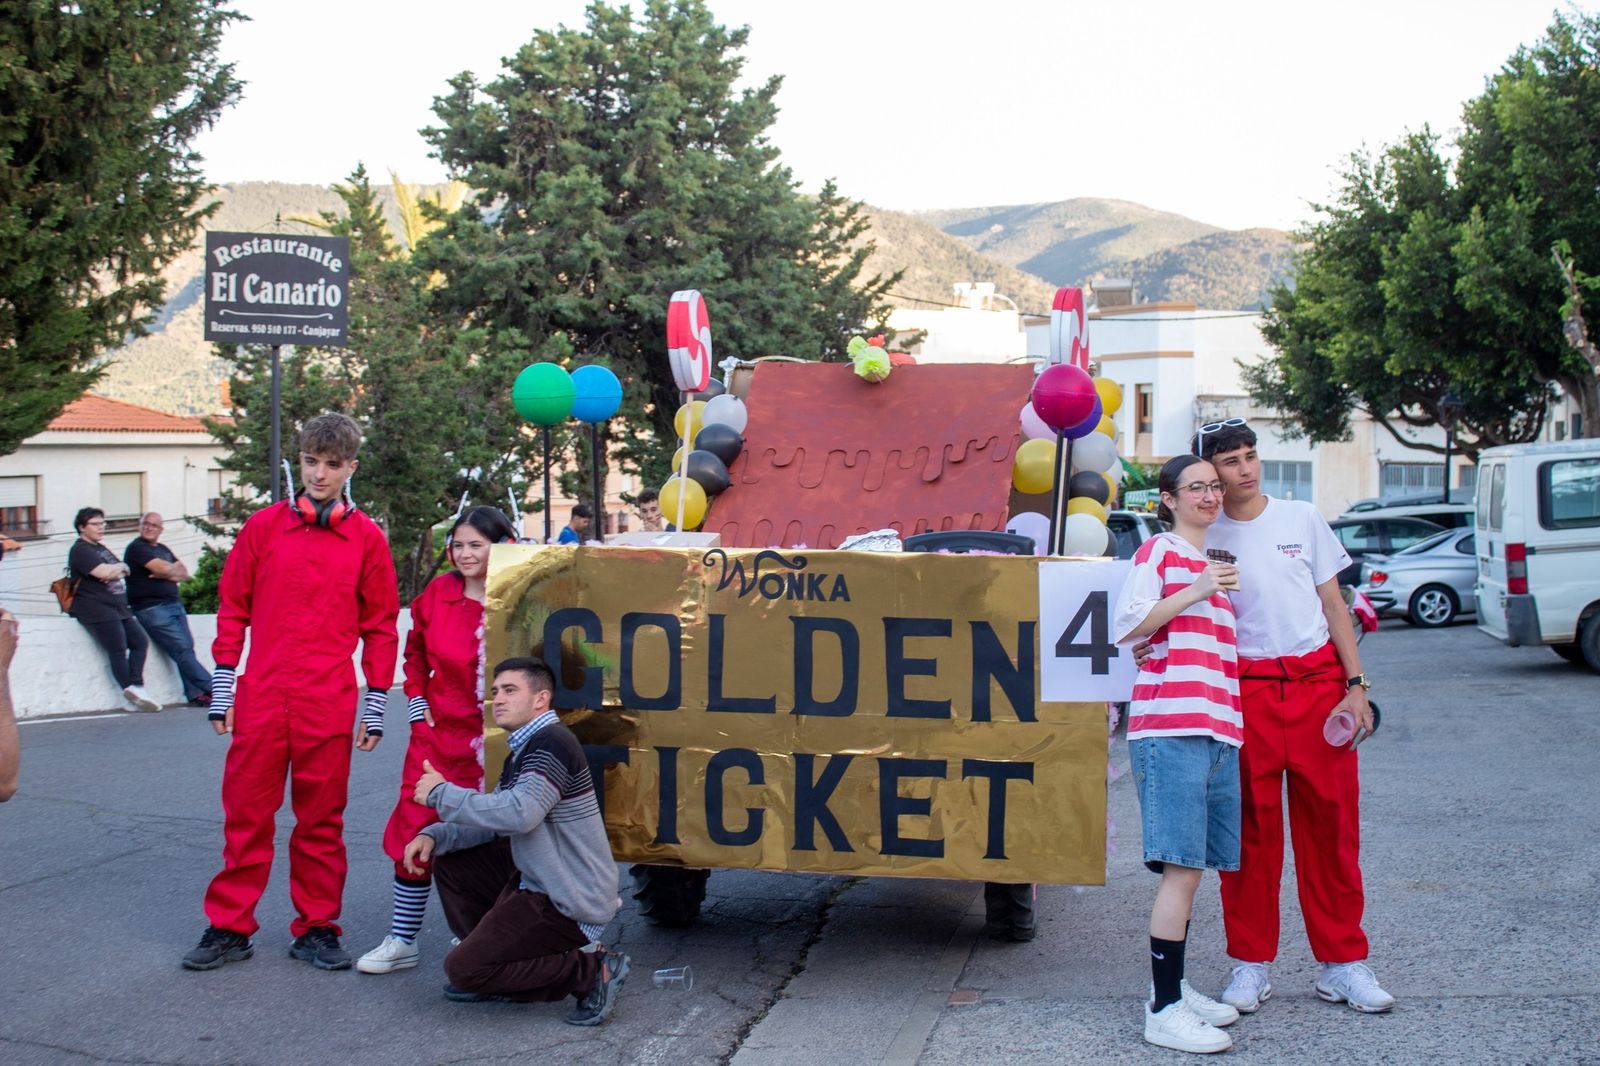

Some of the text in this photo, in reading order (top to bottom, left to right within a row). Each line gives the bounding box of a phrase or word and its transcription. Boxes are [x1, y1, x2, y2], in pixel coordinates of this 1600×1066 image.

[212, 237, 343, 273] Restaurante
[211, 272, 342, 308] El Canario
[1055, 591, 1119, 675] 4
[543, 608, 1038, 722] GOLDEN
